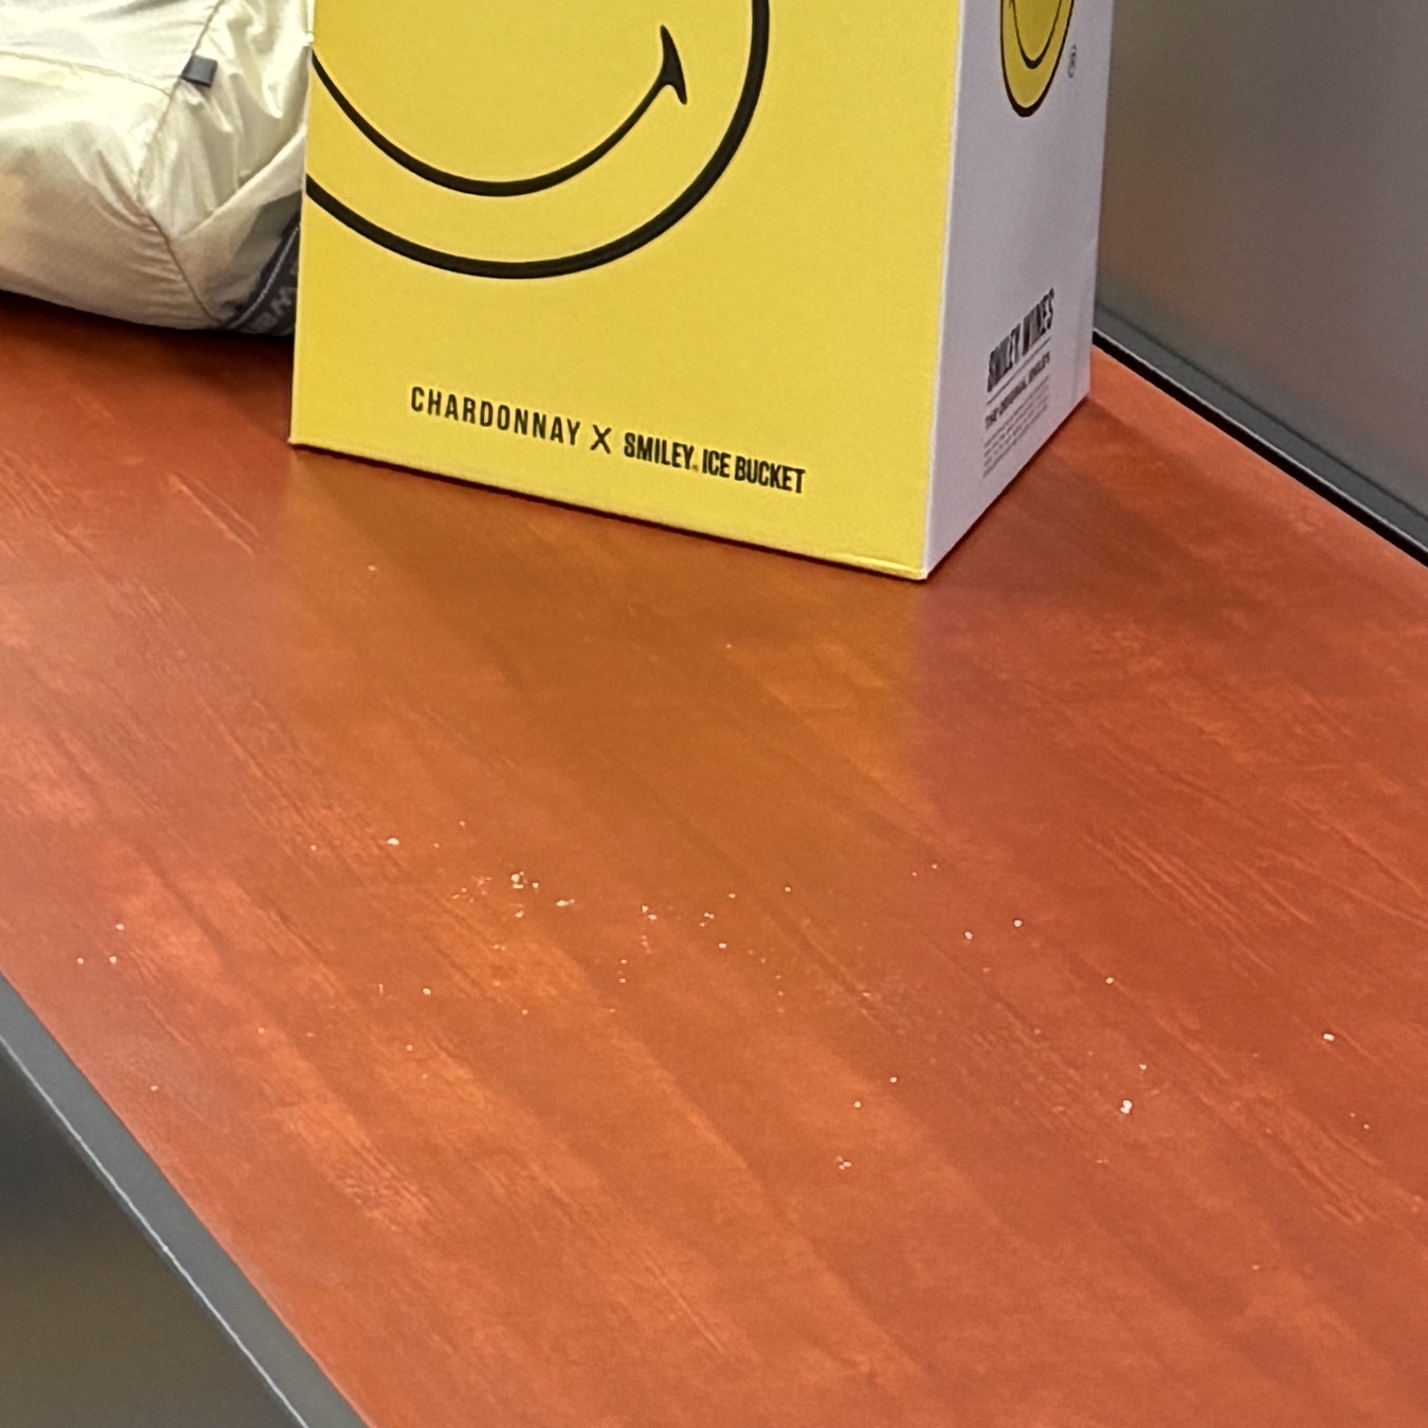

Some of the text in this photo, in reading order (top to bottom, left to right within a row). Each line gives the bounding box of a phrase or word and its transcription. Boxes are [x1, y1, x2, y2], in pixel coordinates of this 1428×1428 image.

[410, 385, 581, 446] CHARDONNAY
[701, 448, 731, 479] ICE
[734, 455, 806, 495] BUCKET
